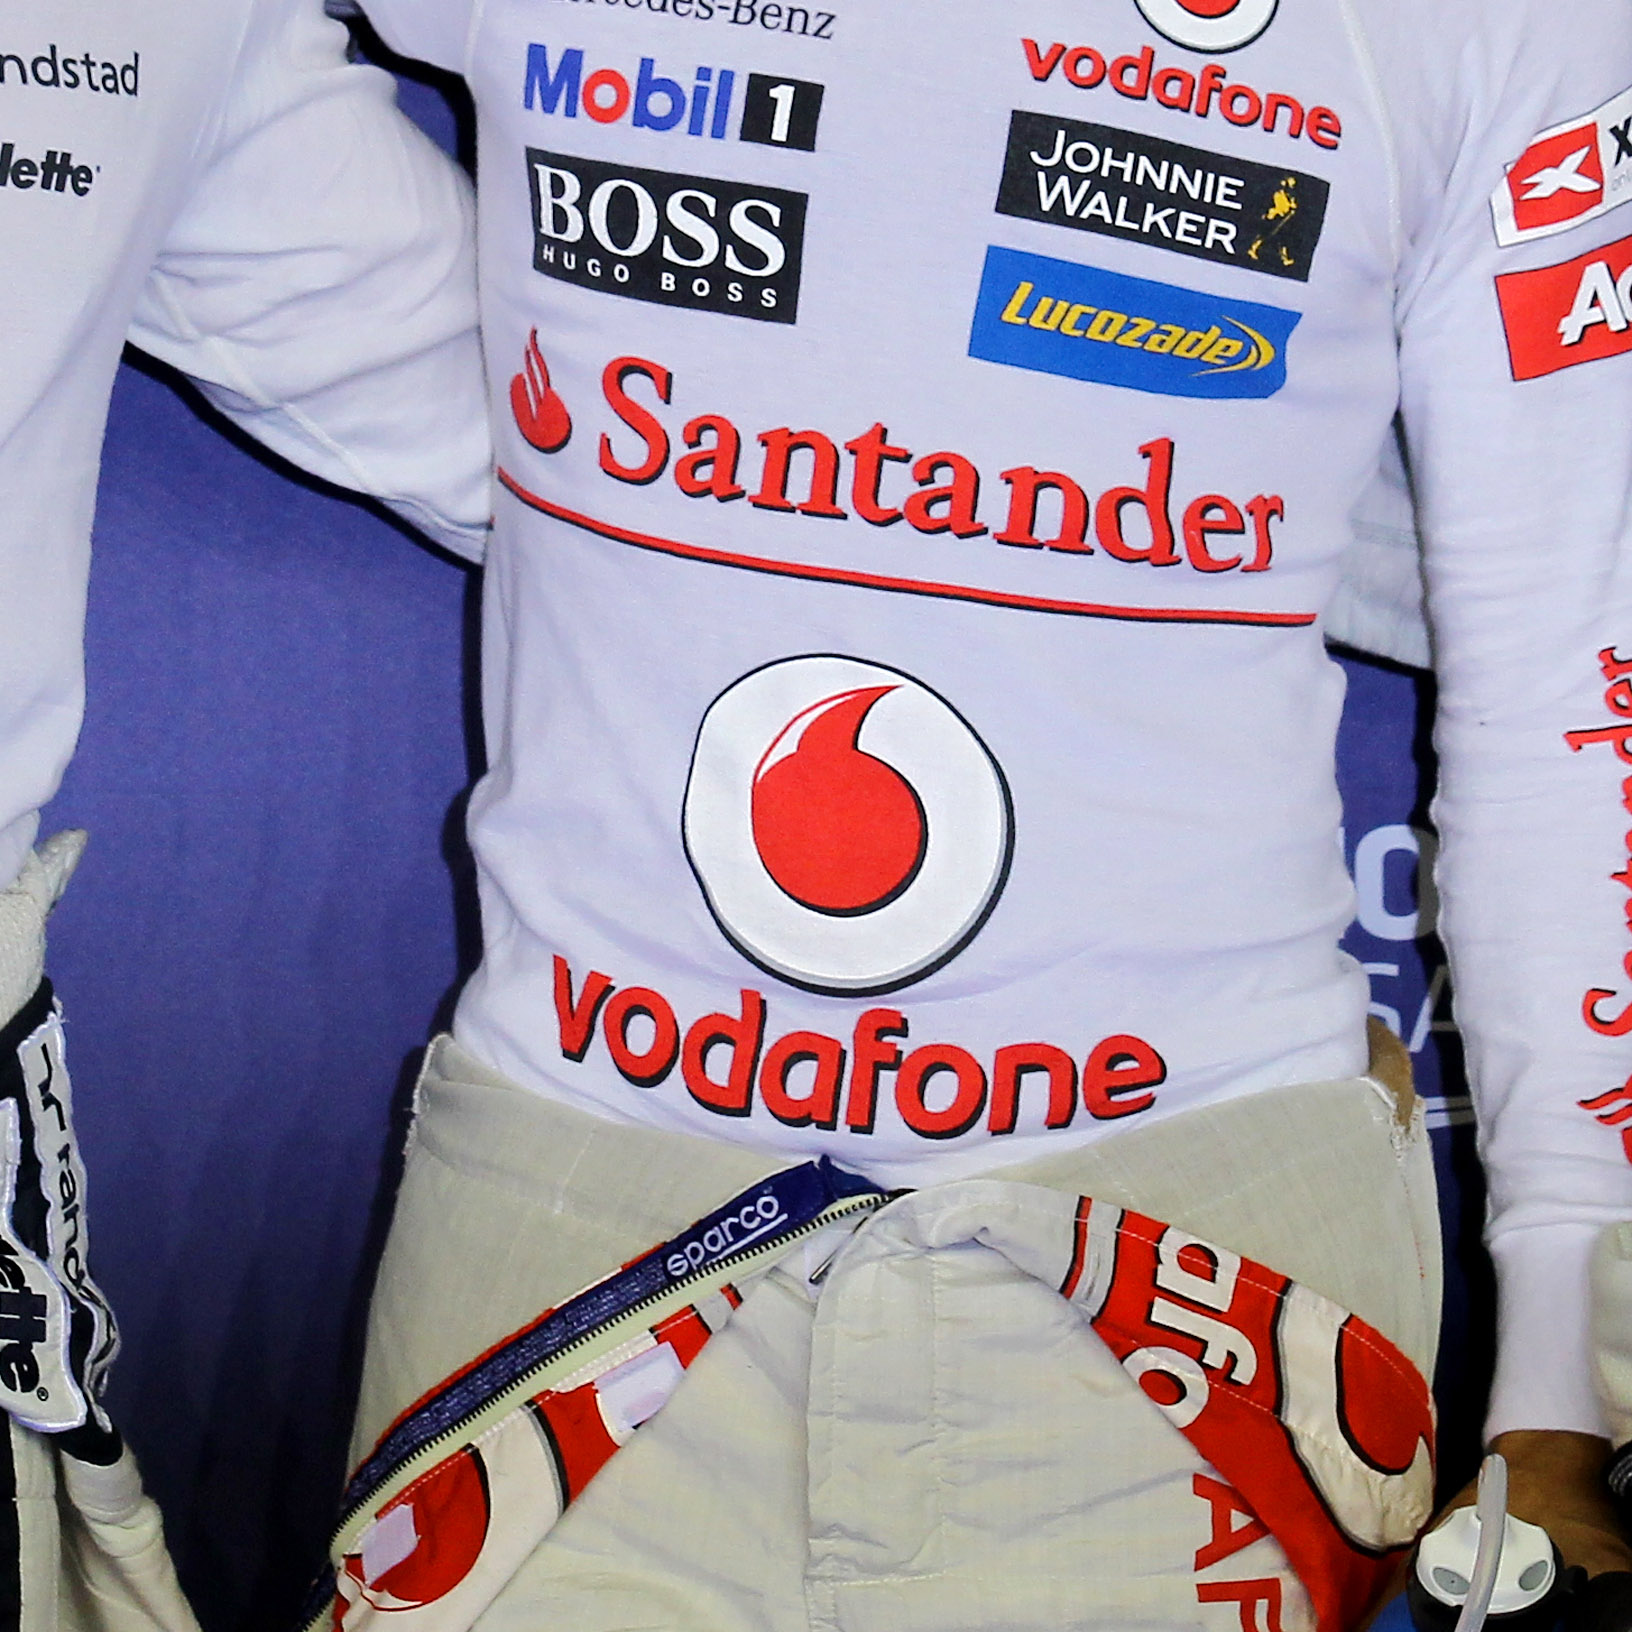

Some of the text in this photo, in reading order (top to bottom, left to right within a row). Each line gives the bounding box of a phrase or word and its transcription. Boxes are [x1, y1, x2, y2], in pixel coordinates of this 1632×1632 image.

[523, 42, 797, 143] Mobil 1
[1020, 37, 1343, 150] vodafone
[532, 161, 787, 278] BOSS
[1029, 128, 1246, 211] JOHNNIE
[1036, 169, 1238, 256] WALKER
[542, 242, 778, 308] HUGO BOSS
[597, 353, 1285, 575] Santander
[551, 953, 1168, 1140] vodafone
[666, 1192, 781, 1278] sparco
